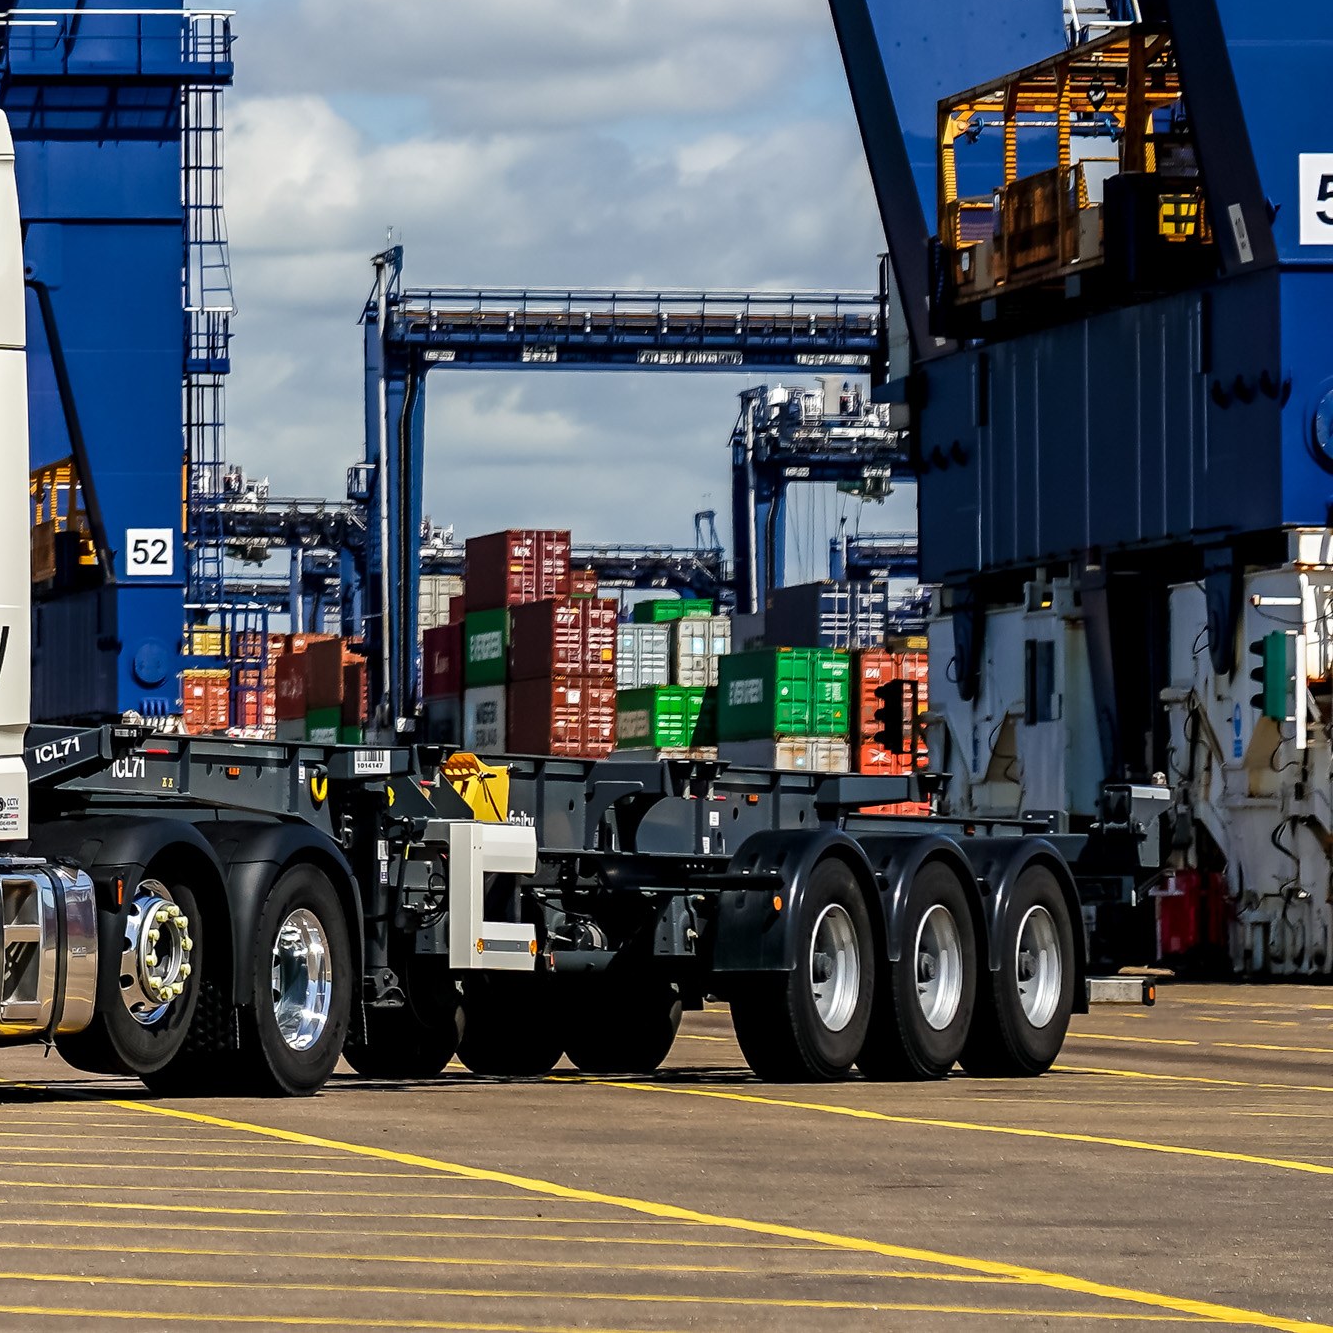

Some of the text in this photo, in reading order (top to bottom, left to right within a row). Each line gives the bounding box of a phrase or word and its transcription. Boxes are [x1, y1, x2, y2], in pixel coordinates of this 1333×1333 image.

[132, 538, 168, 565] 52
[35, 736, 81, 764] ICL71
[112, 756, 146, 778] ICL71
